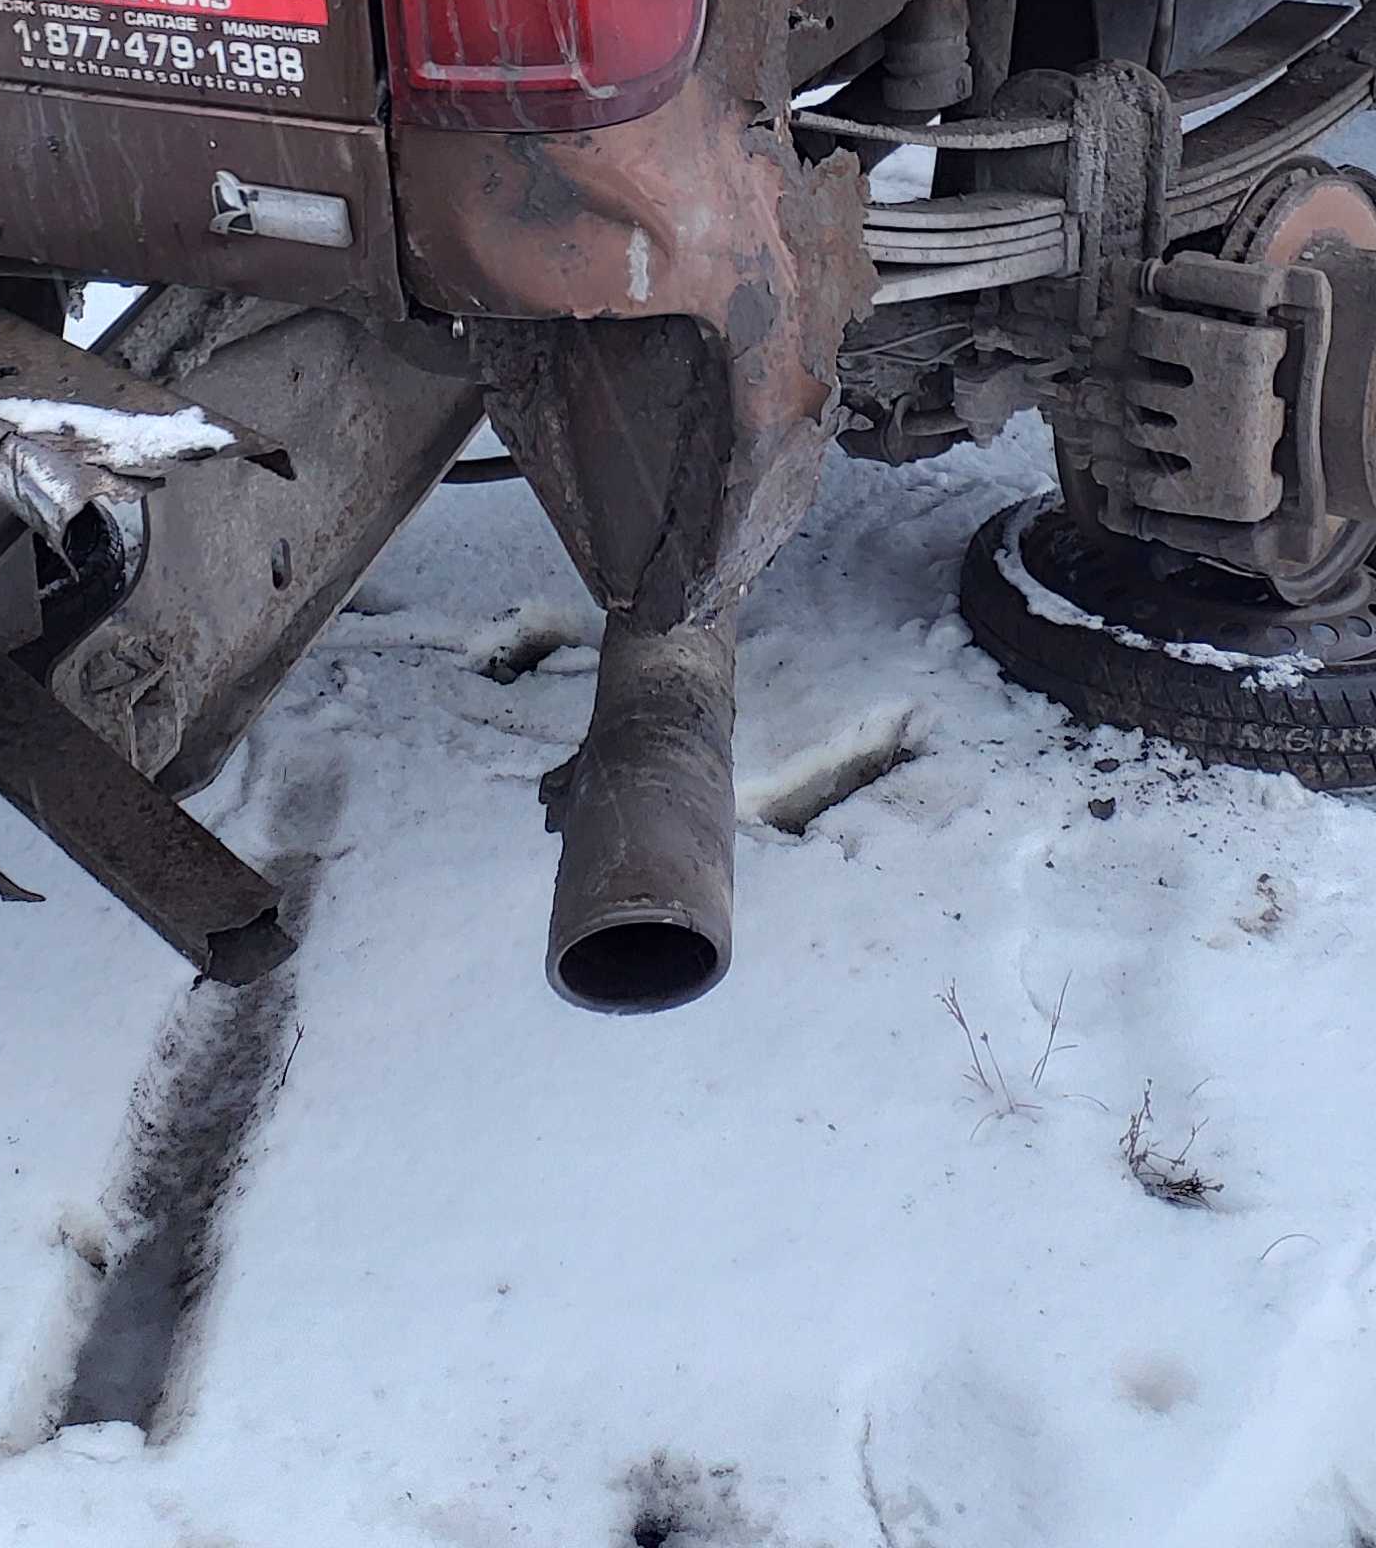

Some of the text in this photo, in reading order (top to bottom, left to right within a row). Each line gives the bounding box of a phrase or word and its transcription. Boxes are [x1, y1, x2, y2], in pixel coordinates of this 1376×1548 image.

[40, 2, 102, 22] TRUCKS
[124, 10, 198, 32] CARTAGE
[223, 22, 321, 44] MANPOWER
